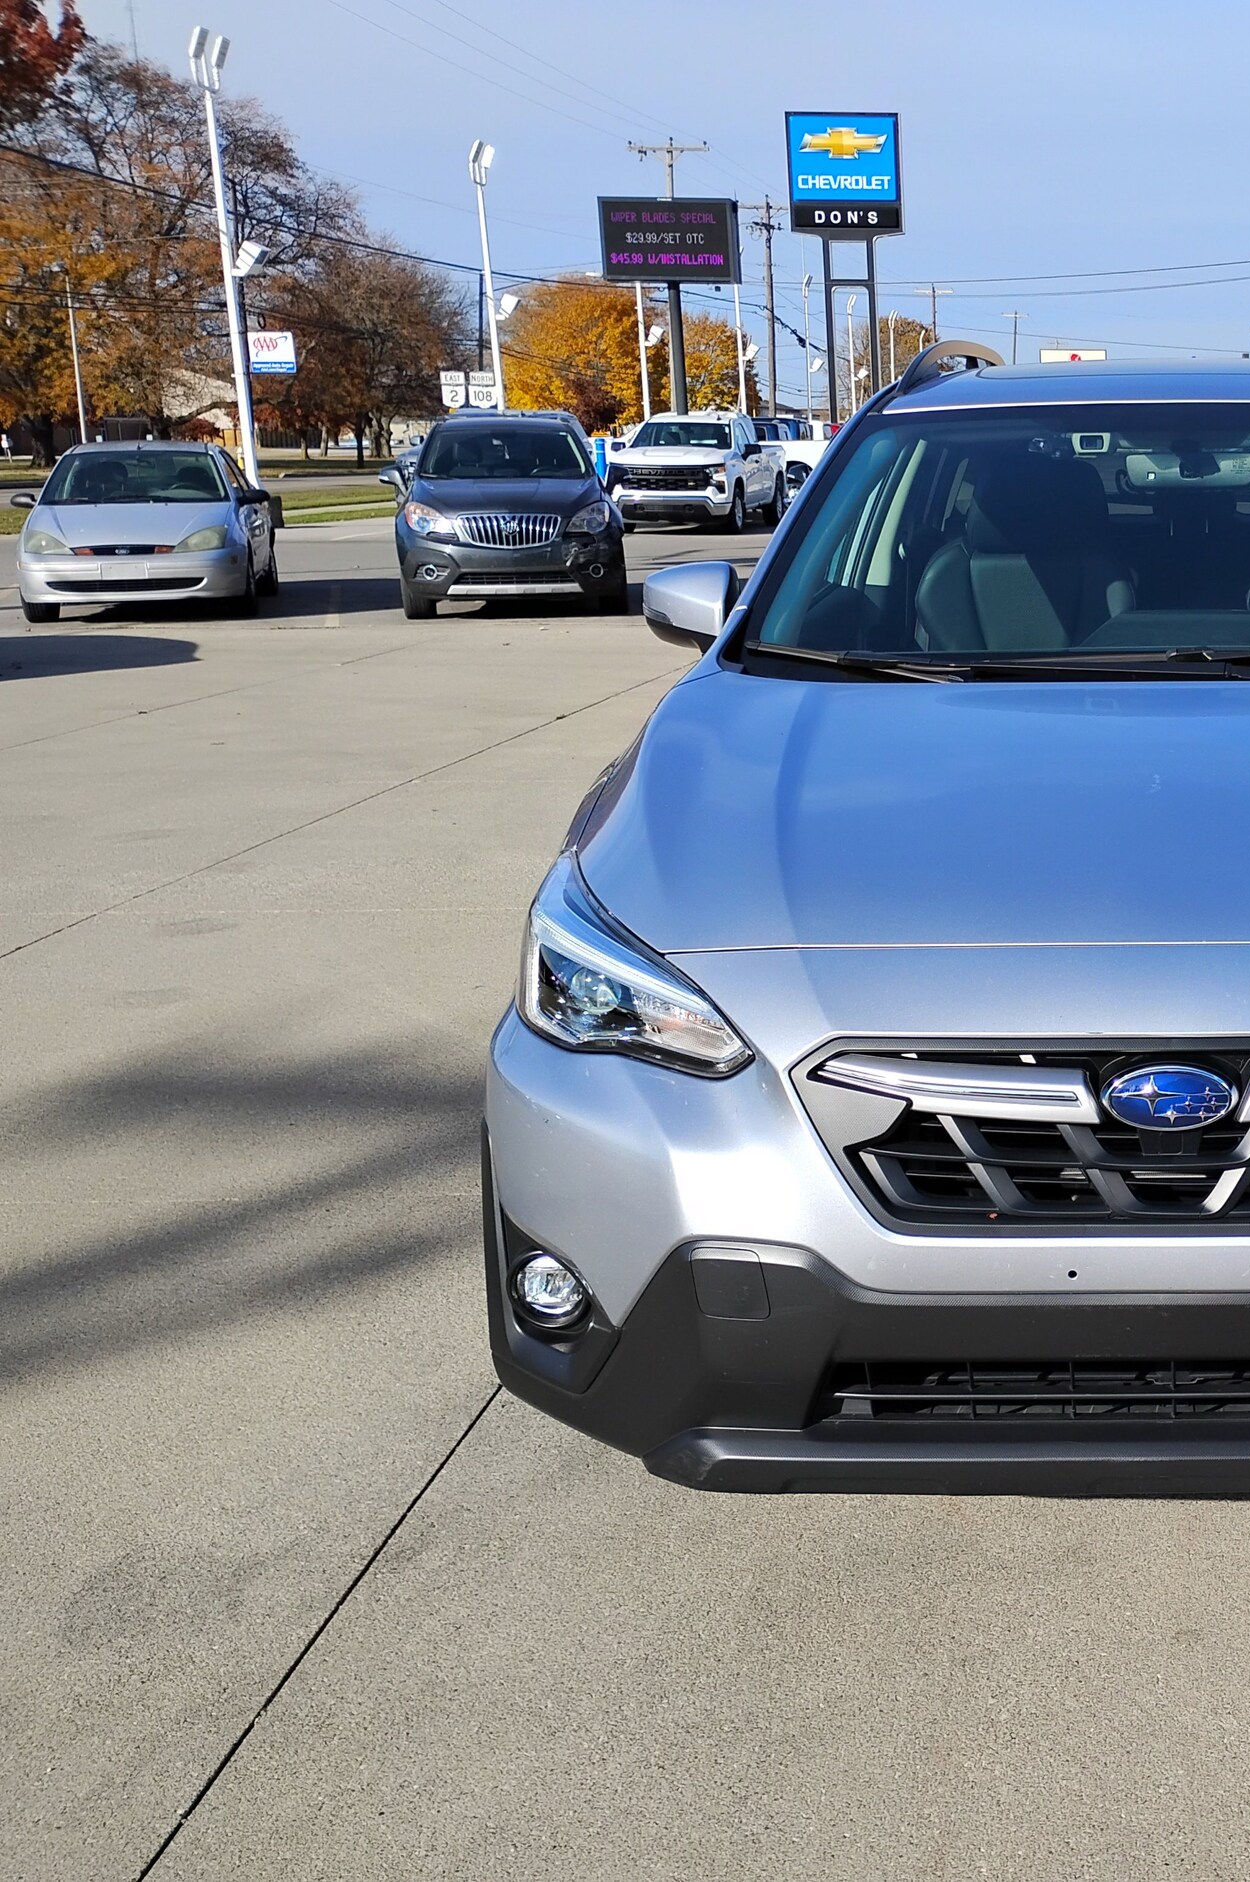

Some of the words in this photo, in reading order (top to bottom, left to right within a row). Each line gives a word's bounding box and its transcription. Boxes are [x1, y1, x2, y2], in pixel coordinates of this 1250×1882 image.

[797, 174, 891, 190] CHEVROLET
[611, 211, 637, 223] WIPER
[642, 212, 676, 223] BLADES
[680, 213, 717, 223] SPECIAL
[814, 210, 878, 224] DON'S
[625, 232, 681, 244] $29.99/SET
[686, 233, 705, 244] OTC
[610, 252, 643, 264] $45.99
[648, 253, 724, 265] W/INSTALLATION
[444, 374, 460, 382] EAST
[449, 389, 459, 403] 2
[473, 390, 493, 402] 108
